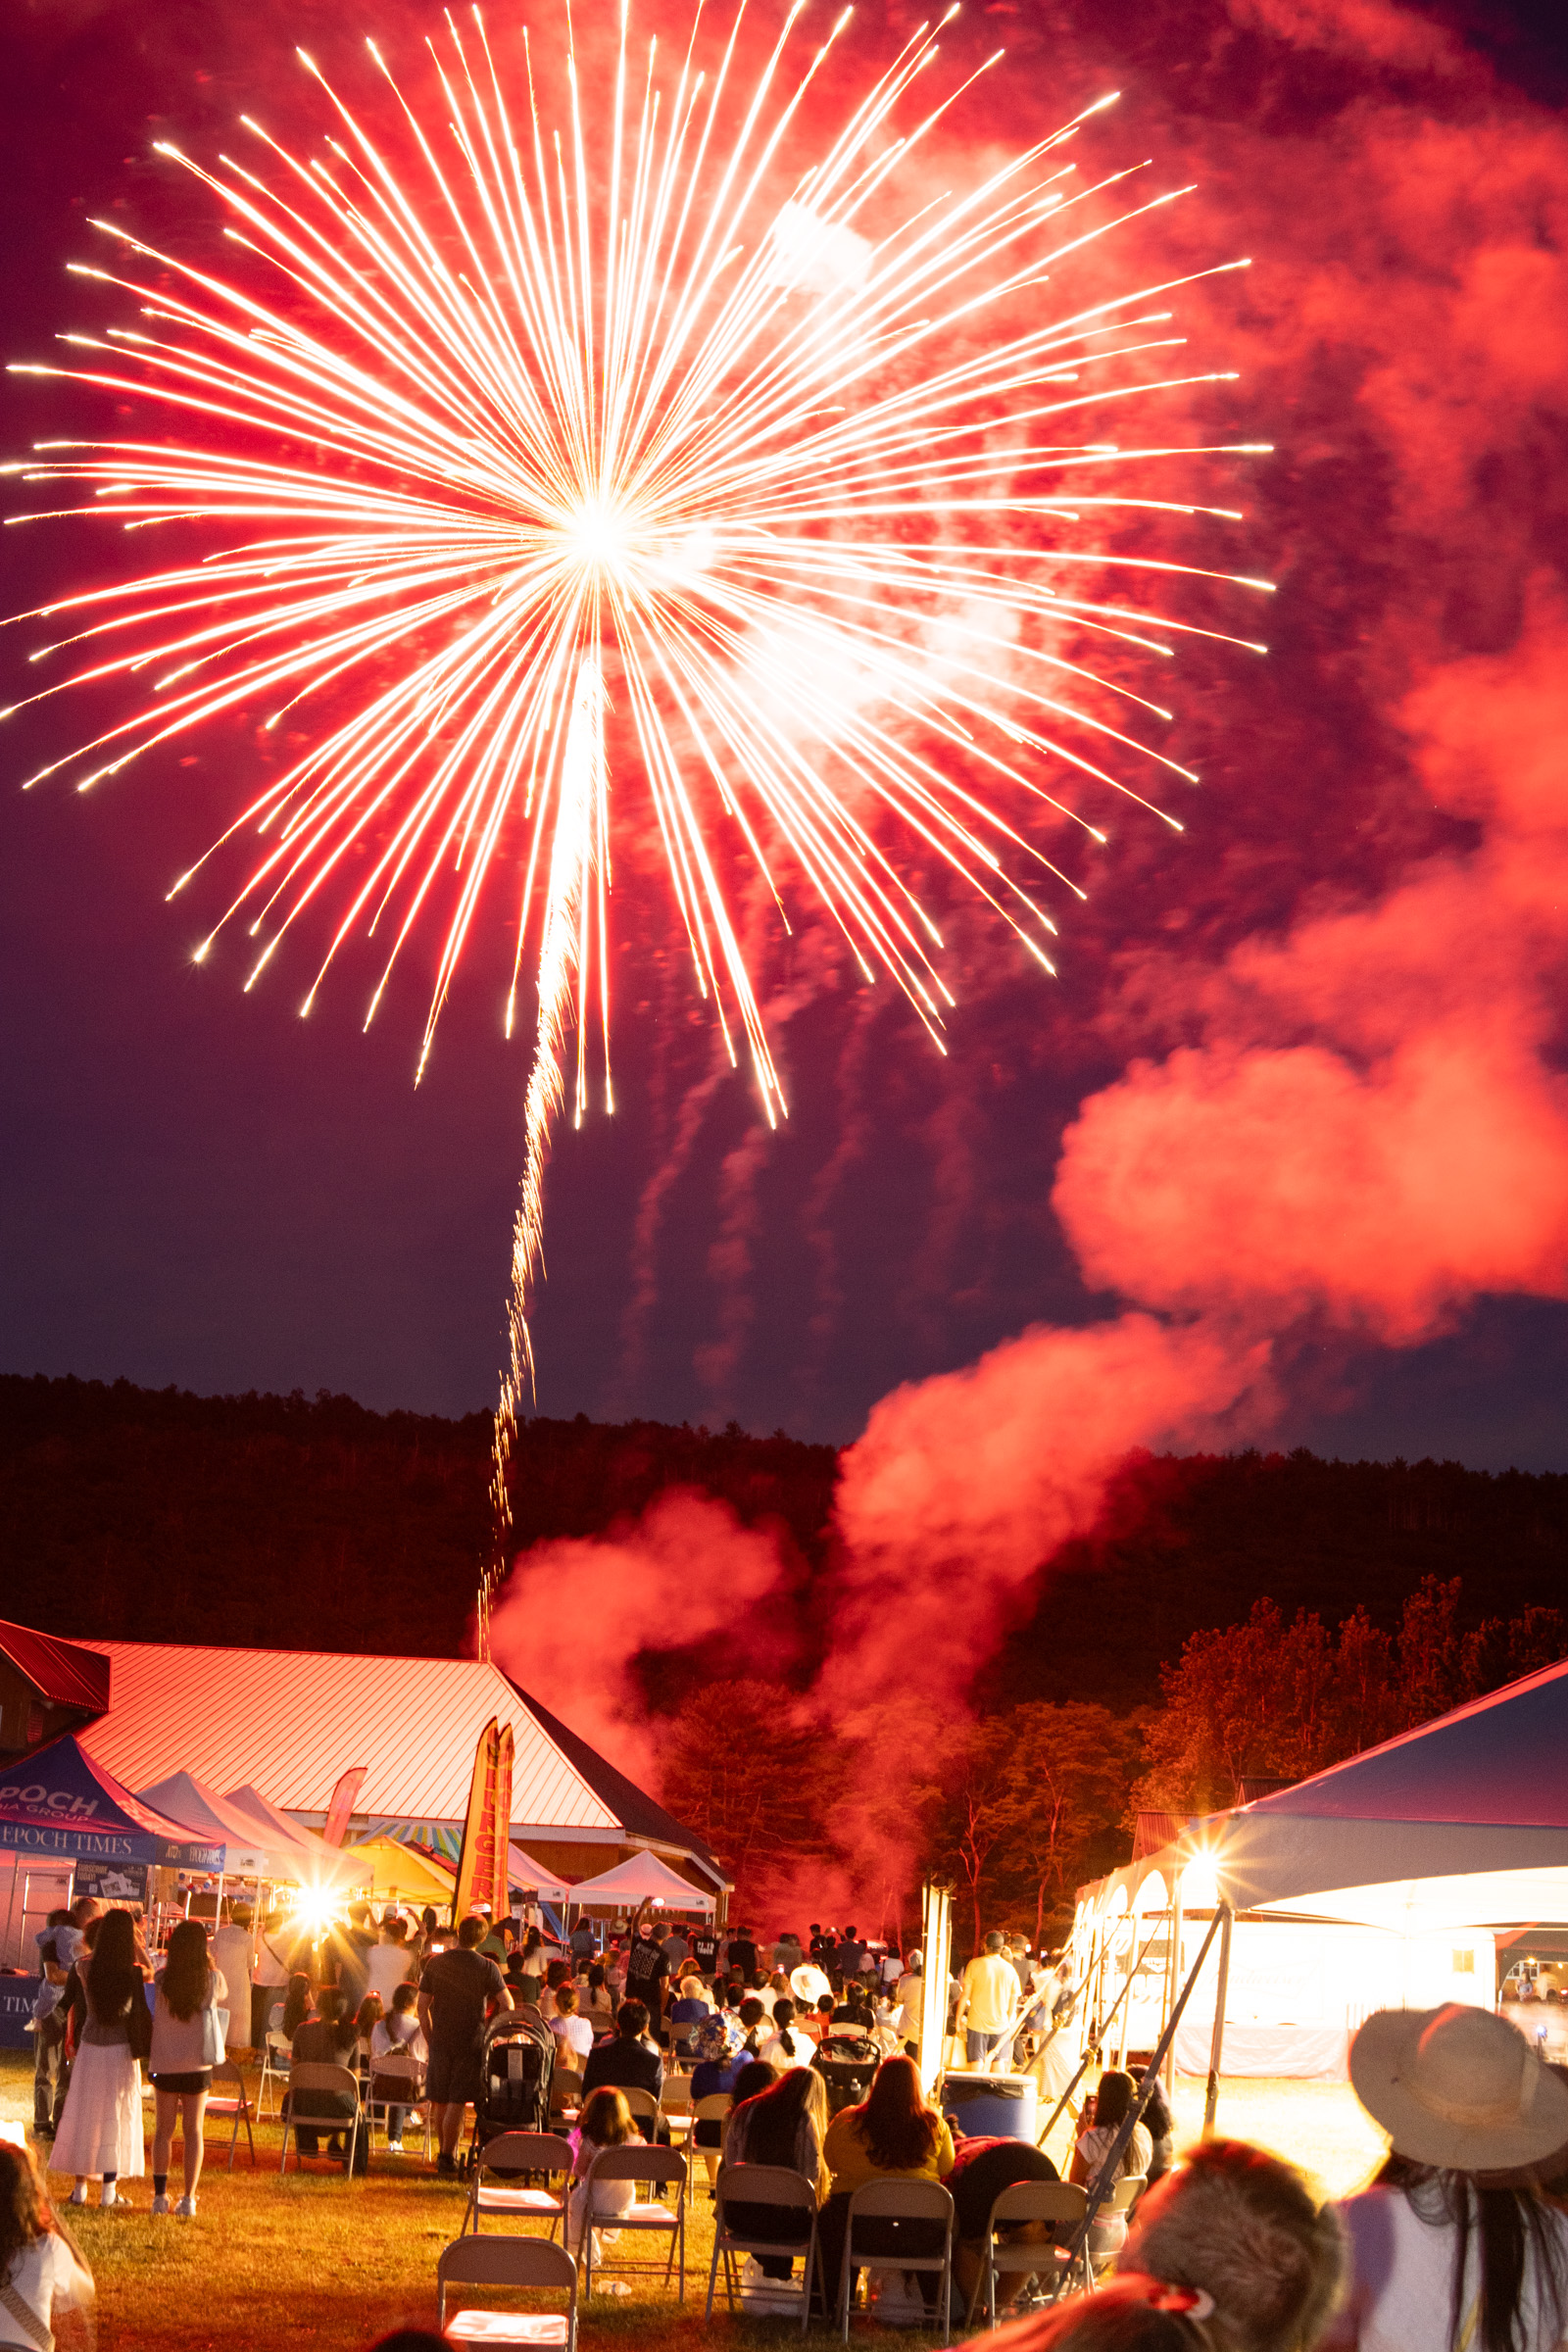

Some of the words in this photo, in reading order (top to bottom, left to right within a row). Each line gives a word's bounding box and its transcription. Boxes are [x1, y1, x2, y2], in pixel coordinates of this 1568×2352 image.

[0, 1786, 98, 1816] POCH
[26, 1804, 89, 1822] GROUP
[2, 1826, 68, 1848] EPOCH
[74, 1834, 132, 1854] TIMES
[3, 1995, 35, 2013] TIM
